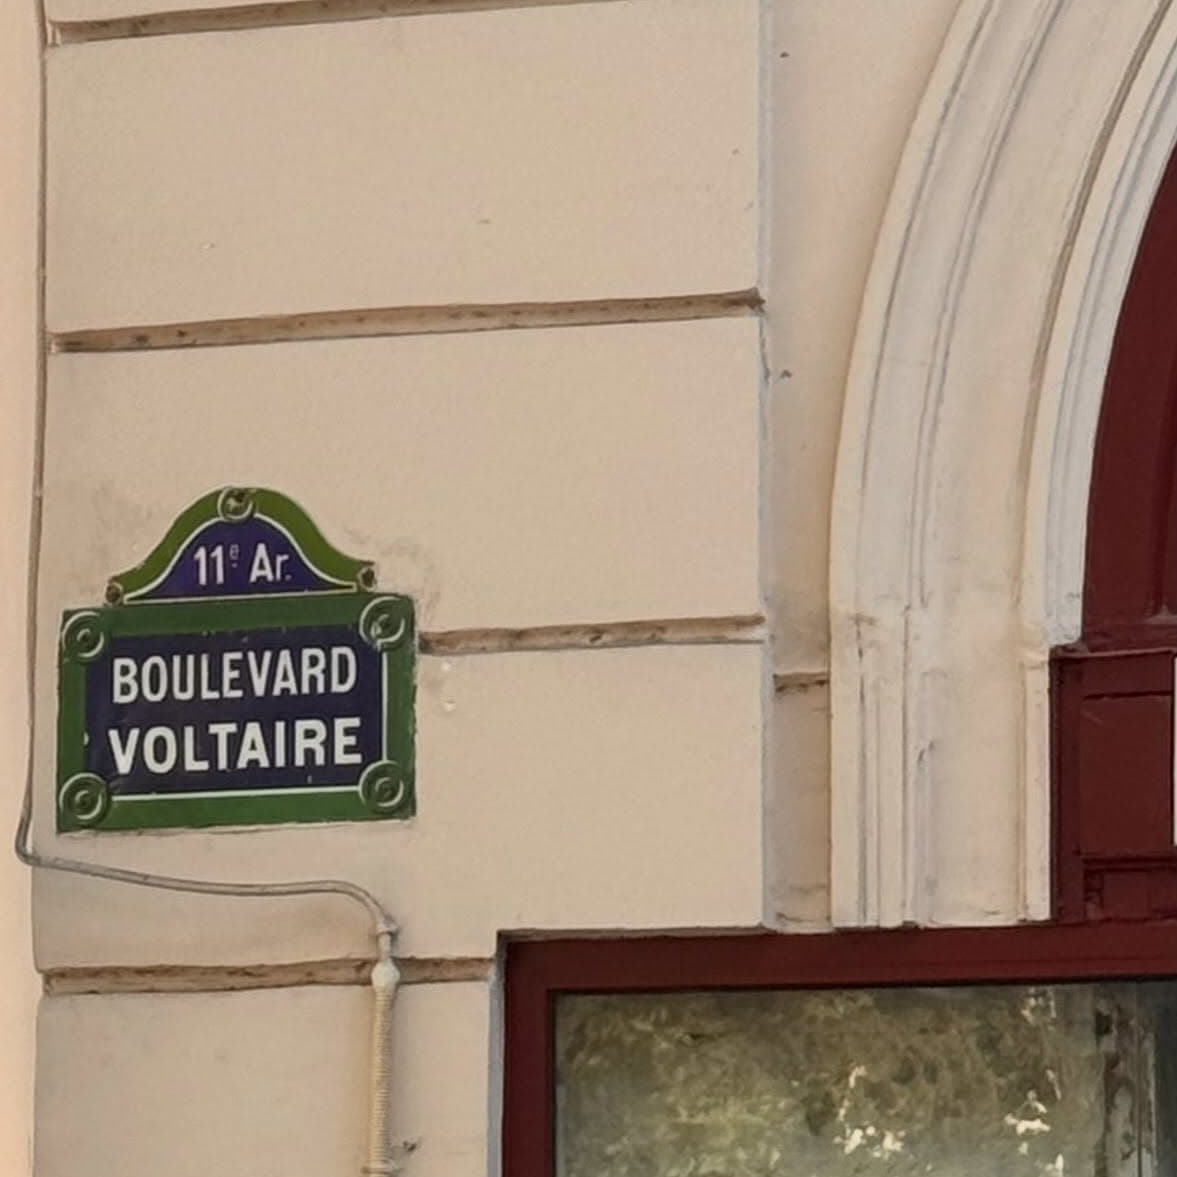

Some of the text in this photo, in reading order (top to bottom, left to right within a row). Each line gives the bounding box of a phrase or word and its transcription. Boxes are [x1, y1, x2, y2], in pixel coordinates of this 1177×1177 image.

[249, 543, 291, 582] Ar.
[112, 647, 358, 704] BOULEVARD
[108, 717, 363, 774] VOLTAIRE
